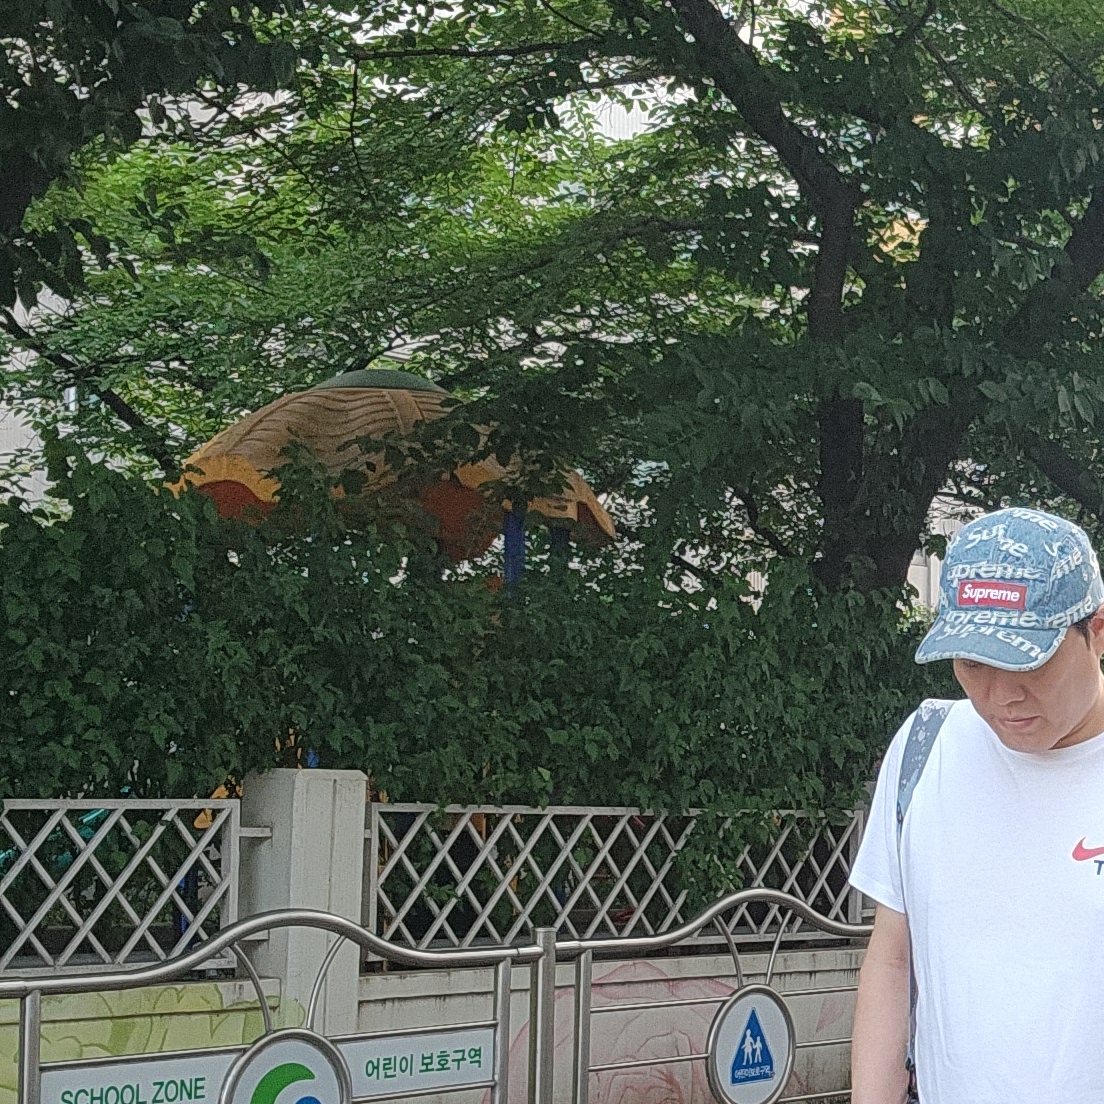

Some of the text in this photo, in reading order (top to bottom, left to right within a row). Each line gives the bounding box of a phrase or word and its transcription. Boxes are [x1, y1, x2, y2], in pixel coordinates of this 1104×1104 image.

[962, 583, 1020, 603] Supreme
[365, 1046, 482, 1080] 어린이 보호구역
[152, 1076, 206, 1104] ZONE
